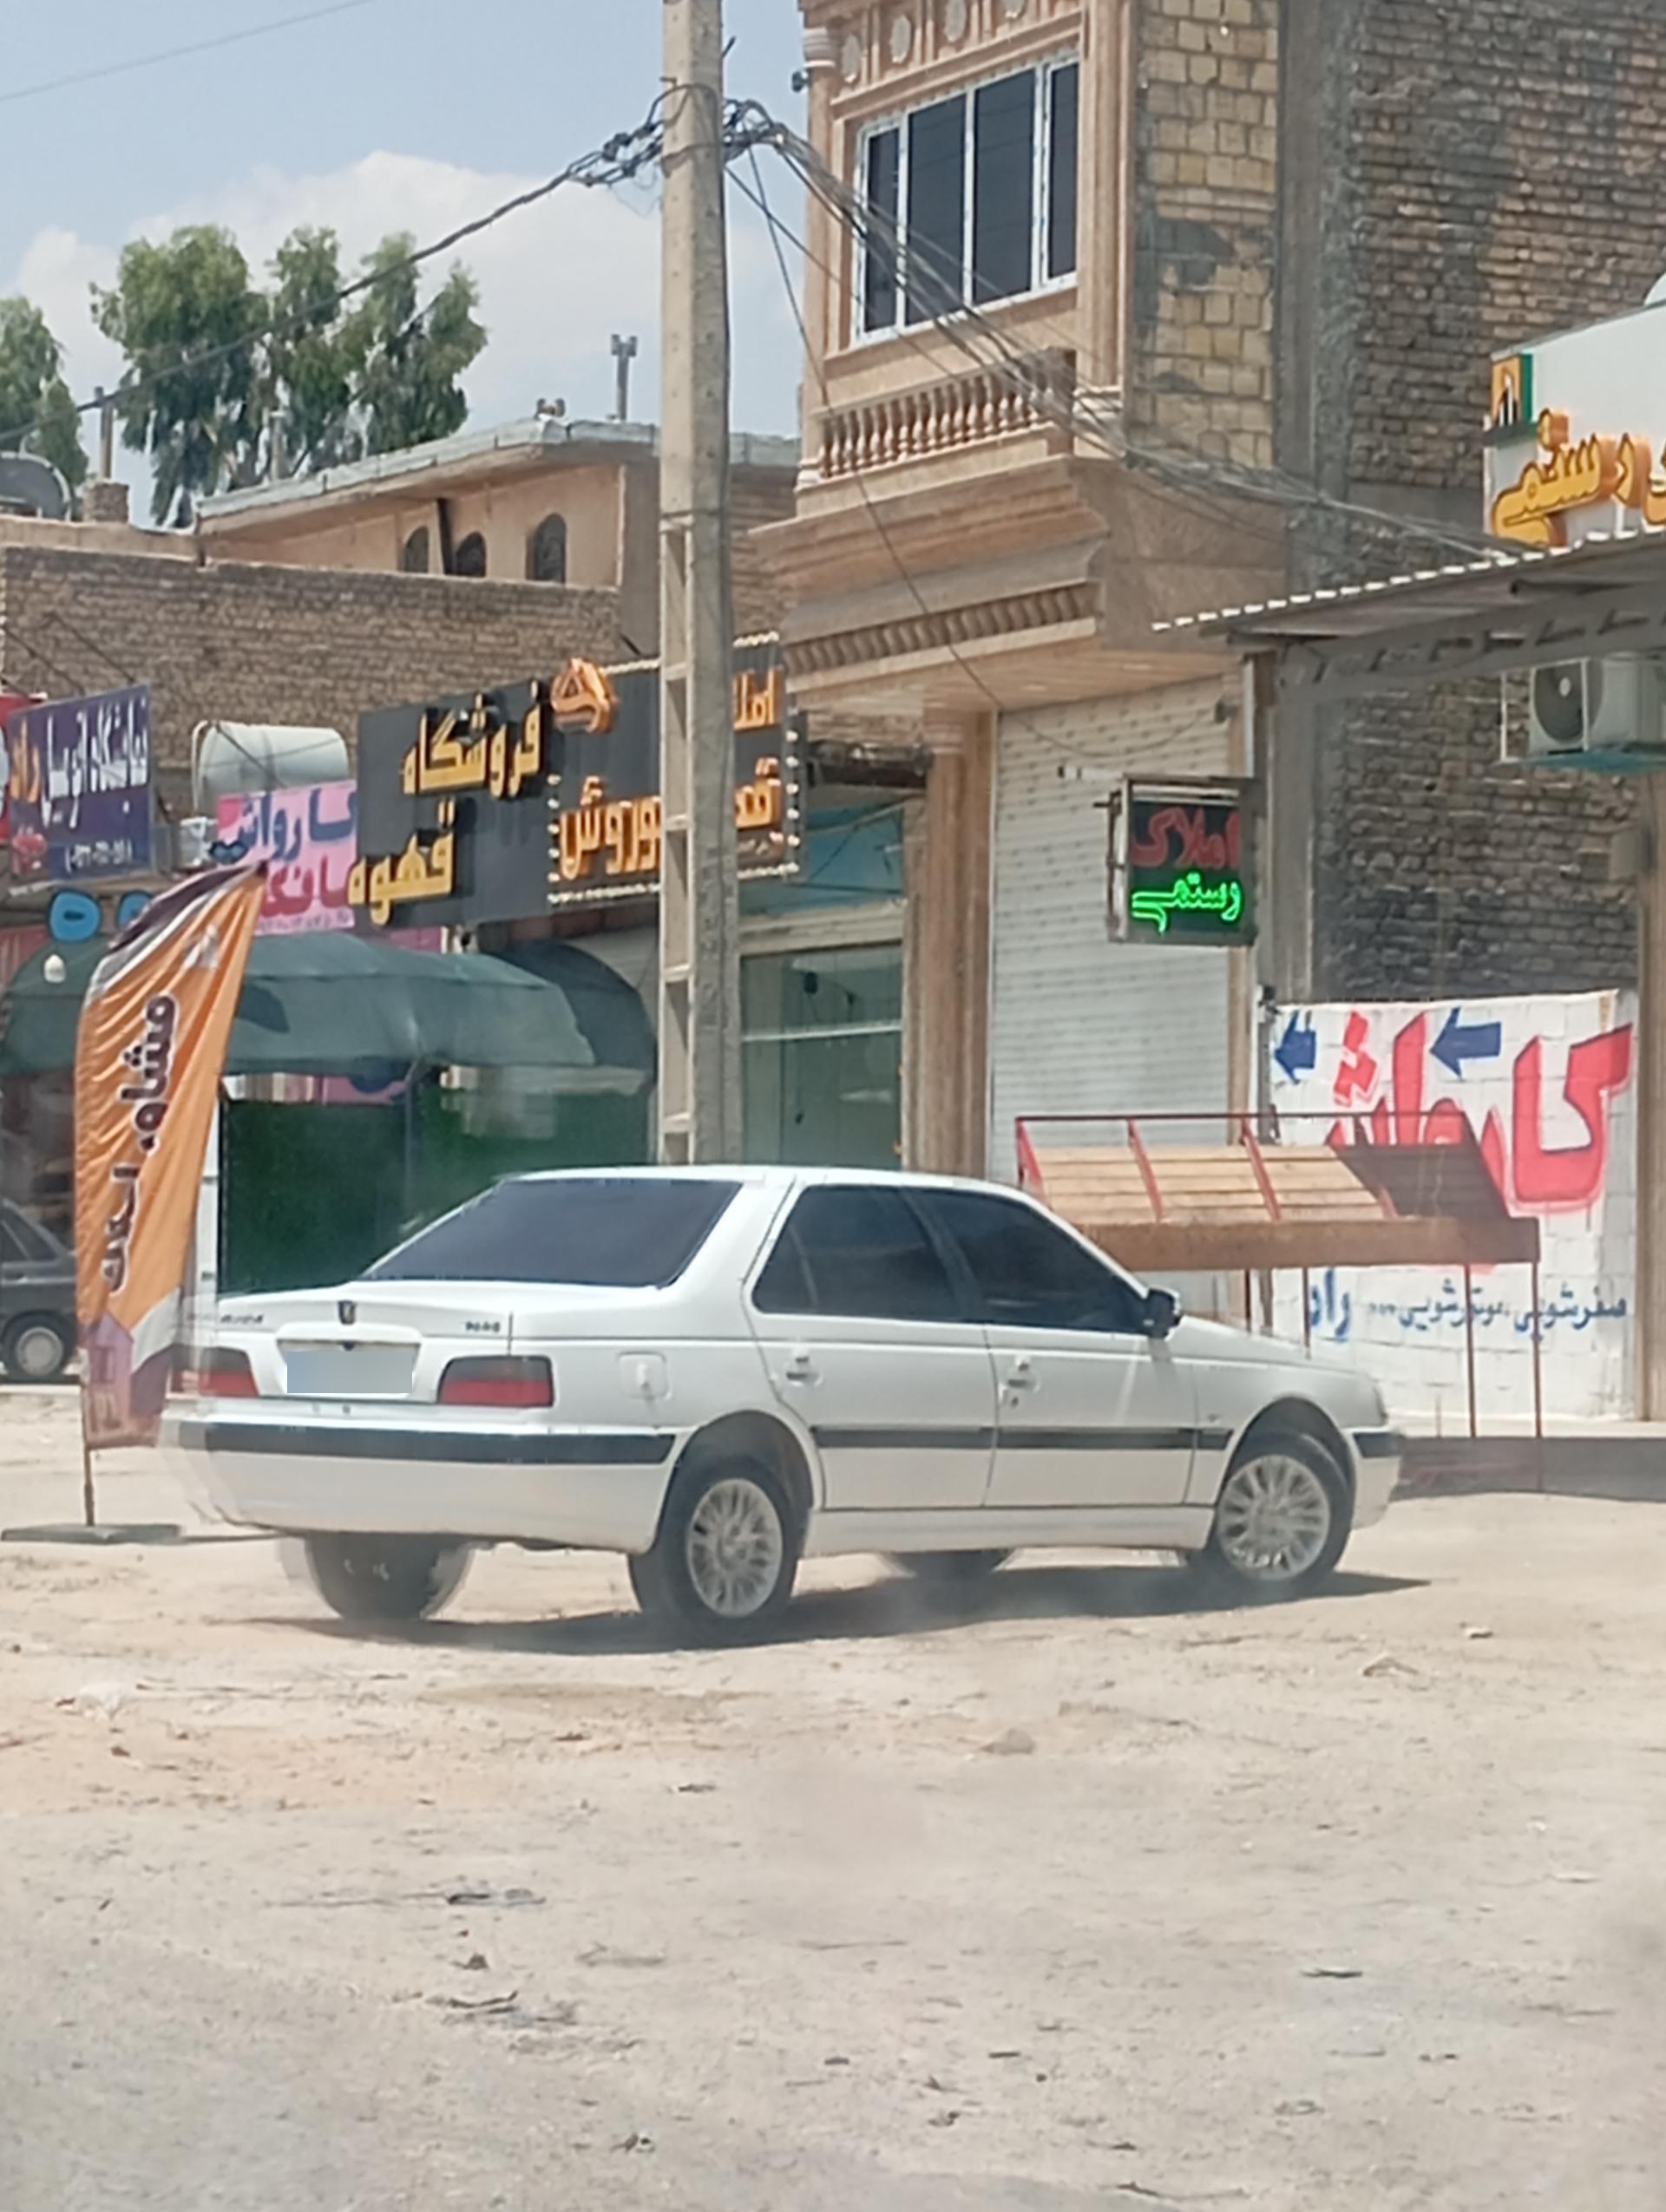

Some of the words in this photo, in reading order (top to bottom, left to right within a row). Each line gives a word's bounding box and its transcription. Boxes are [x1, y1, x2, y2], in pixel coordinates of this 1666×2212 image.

[399, 679, 541, 796] فروشگاه
[348, 797, 454, 926] قهوه
[1131, 807, 1242, 867] املاک
[1131, 871, 1242, 934] رستمی
